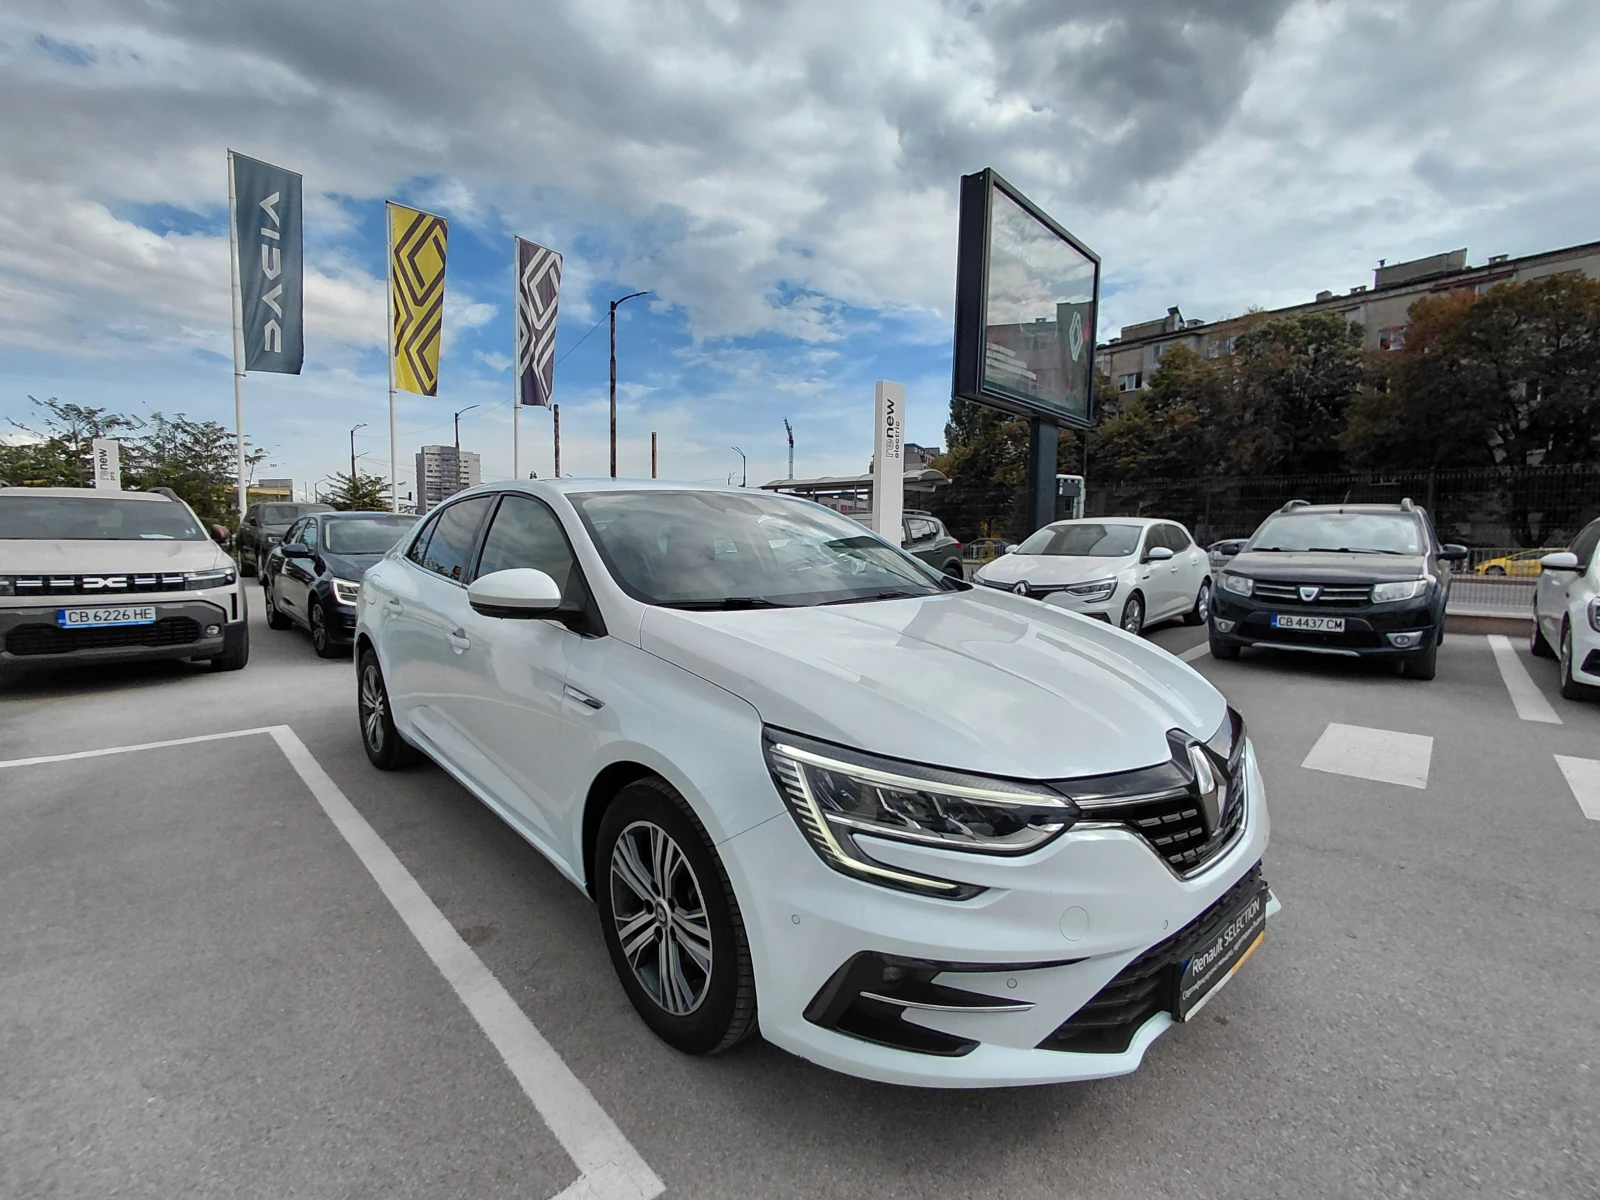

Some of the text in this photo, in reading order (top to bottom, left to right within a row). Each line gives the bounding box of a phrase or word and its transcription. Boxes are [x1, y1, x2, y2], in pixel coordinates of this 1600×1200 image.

[885, 398, 895, 459] renew
[68, 608, 153, 623] CB 6226 HE
[1278, 616, 1343, 630] CB 4437 CM
[1192, 937, 1223, 977] Renault
[1223, 896, 1260, 947] SELECTION
